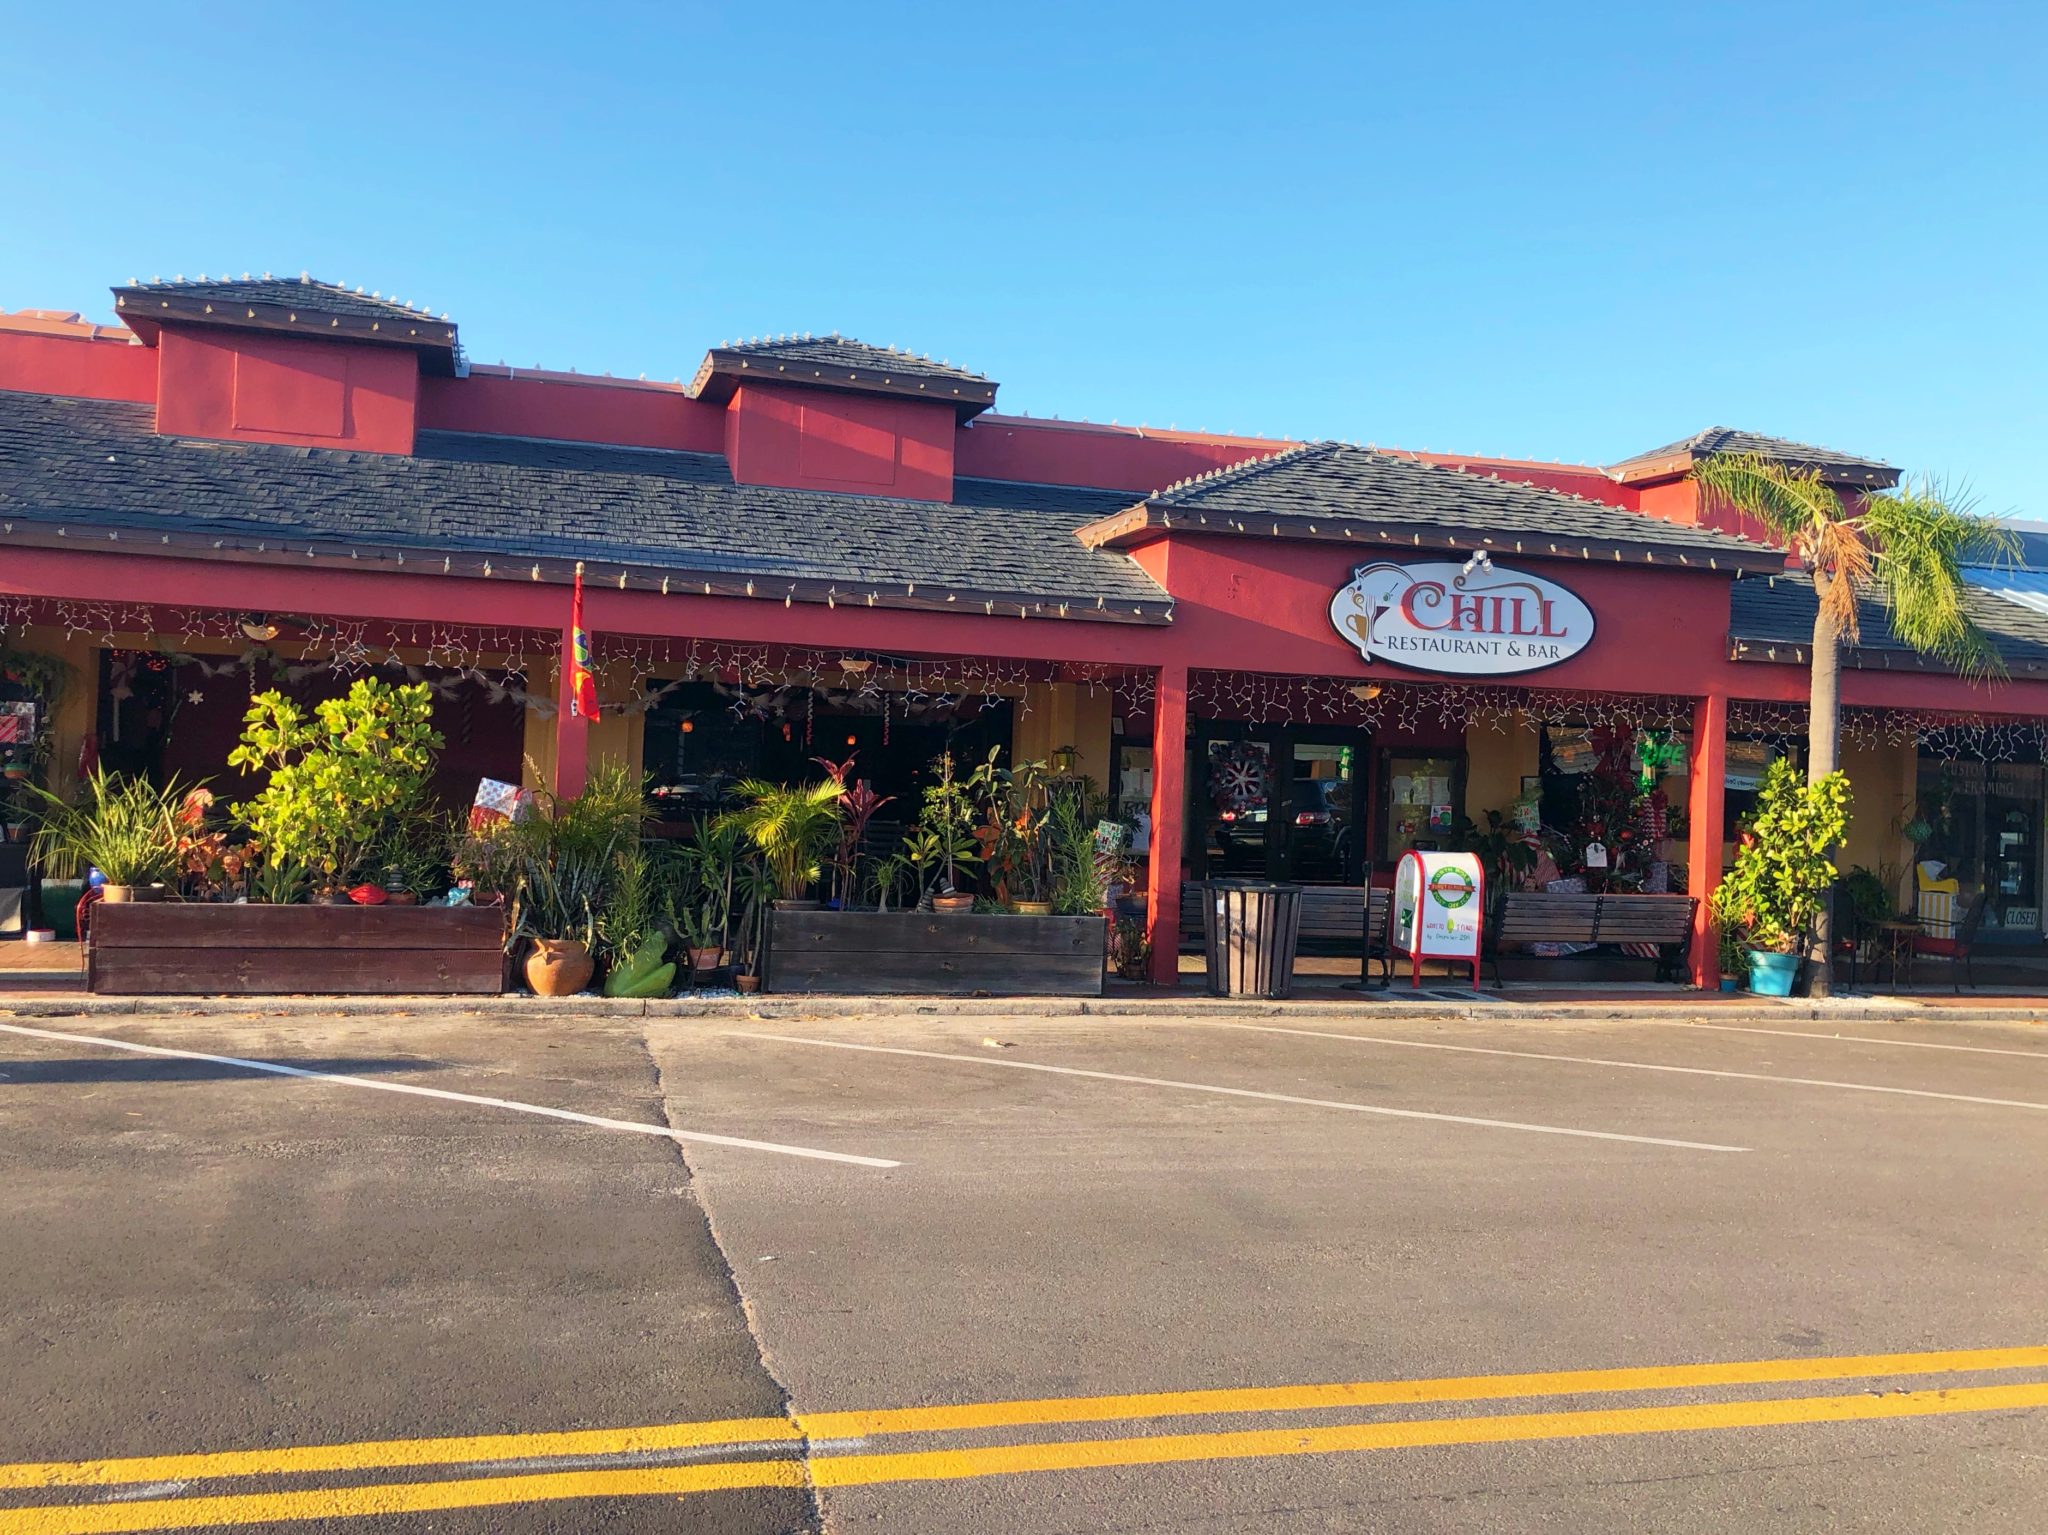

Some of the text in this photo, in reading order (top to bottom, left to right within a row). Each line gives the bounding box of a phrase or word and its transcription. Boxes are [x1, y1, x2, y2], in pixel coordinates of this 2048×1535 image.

[1400, 577, 1567, 637] CHILL
[1387, 635, 1561, 659] RESTAURANT & BAR
[1965, 781, 2014, 794] FRAMING
[2007, 911, 2036, 925] CLOSED
